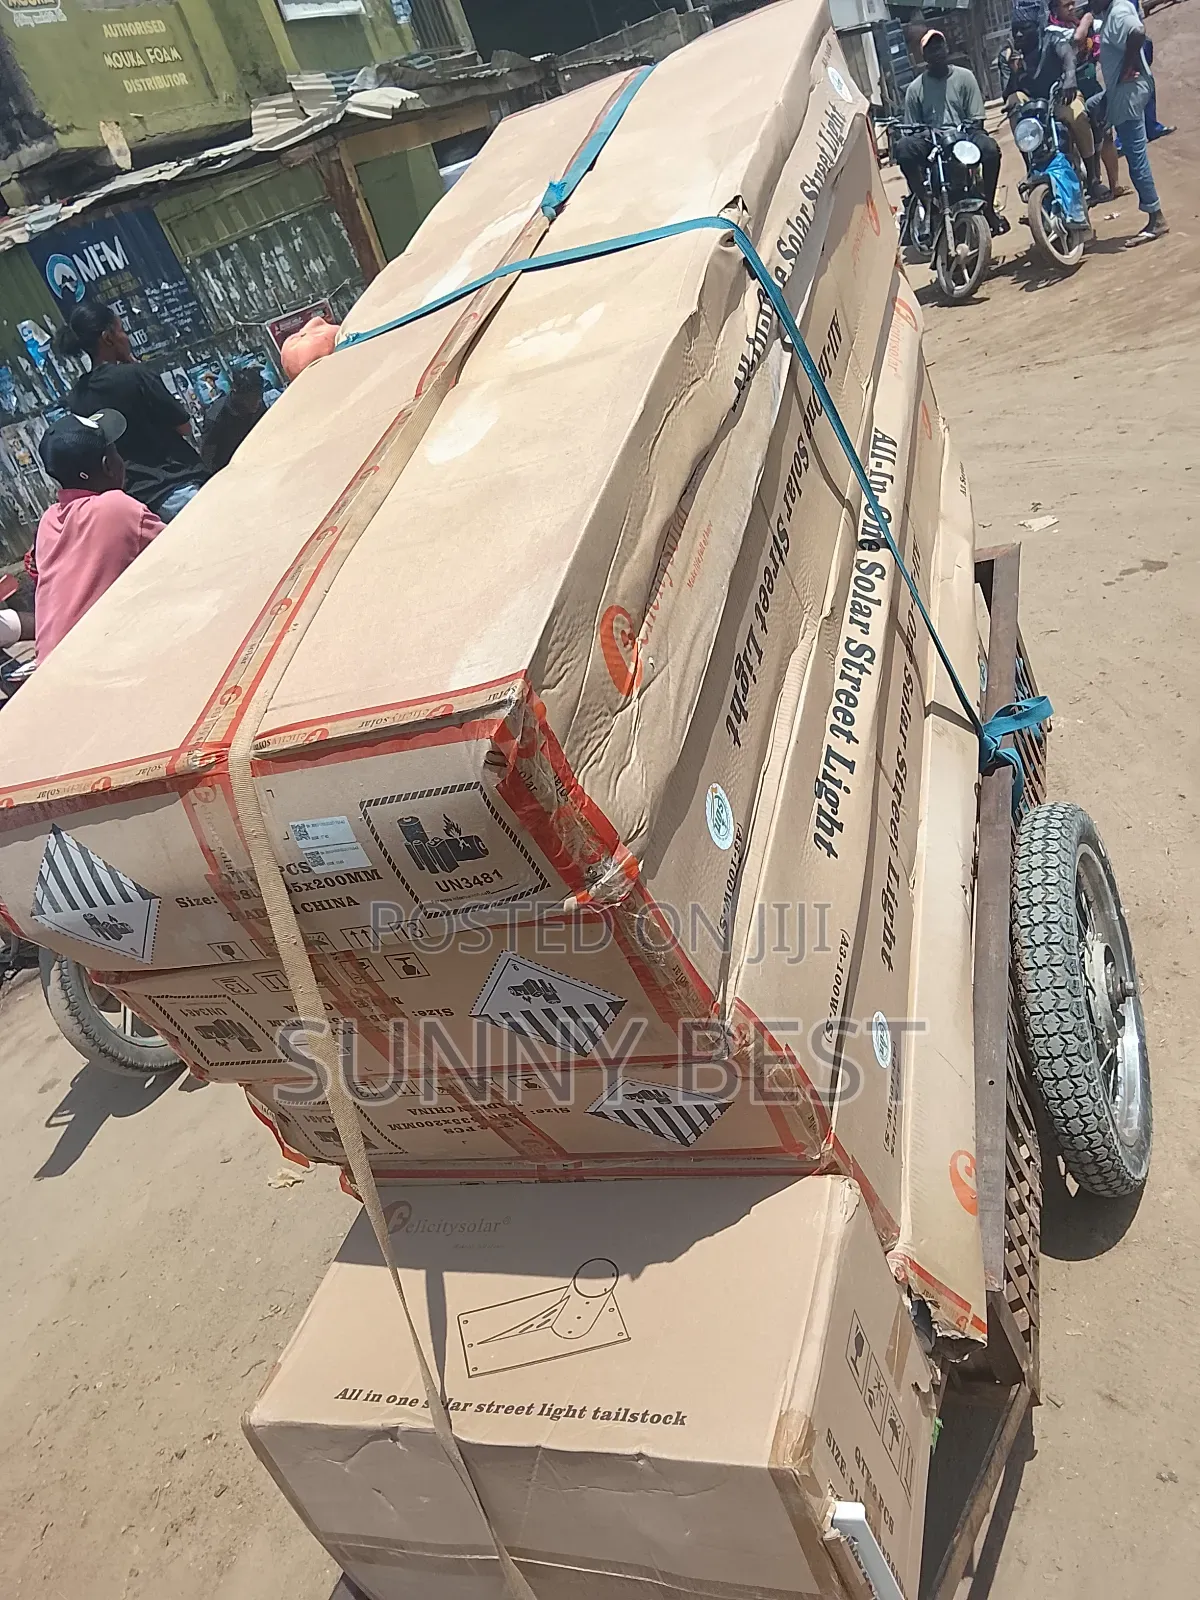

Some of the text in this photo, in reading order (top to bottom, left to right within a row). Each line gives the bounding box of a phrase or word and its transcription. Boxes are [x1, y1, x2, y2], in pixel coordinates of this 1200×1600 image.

[102, 20, 167, 38] AUTHORISED
[103, 45, 183, 69] MOUKA FOAM
[122, 72, 189, 93] DISTRIBUTOR
[776, 205, 813, 268] Solar
[800, 146, 836, 203] Street
[820, 100, 847, 158] Light
[781, 432, 810, 517] Solar
[755, 511, 790, 635] Street
[847, 557, 887, 637] Solar
[725, 620, 766, 749] Light
[831, 640, 877, 745] Street
[518, 770, 538, 792] olar
[814, 745, 857, 861] Light
[888, 743, 908, 857] Street
[174, 892, 218, 909] Size:
[300, 894, 361, 914] CHINA
[434, 868, 504, 893] UN3481
[881, 854, 901, 974] Light
[411, 1007, 455, 1018] Size:
[823, 927, 852, 1045] (A3-100W-S)
[407, 1106, 457, 1116] CHINA
[334, 1386, 688, 1427] All in one slar street light tailstock
